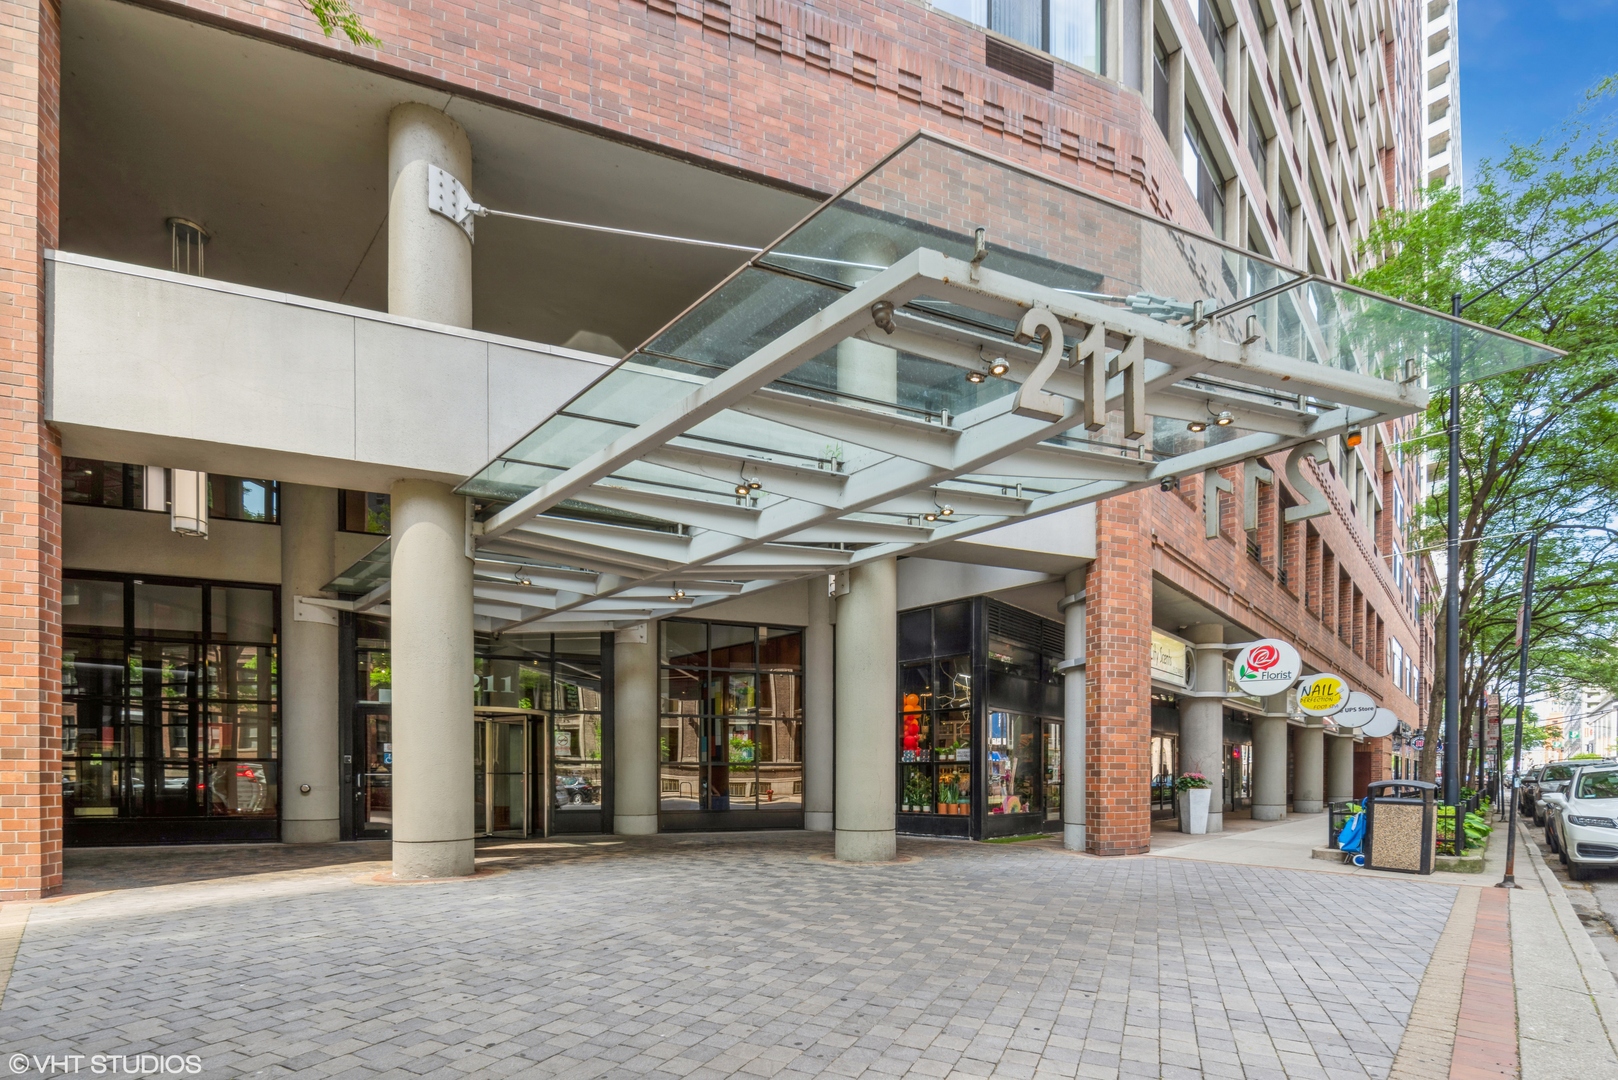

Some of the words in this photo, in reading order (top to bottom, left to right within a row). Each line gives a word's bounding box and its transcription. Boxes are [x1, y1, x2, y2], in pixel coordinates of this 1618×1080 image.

[1012, 307, 1145, 440] 211
[1261, 670, 1292, 680] Florist
[1301, 683, 1334, 697] NAIL
